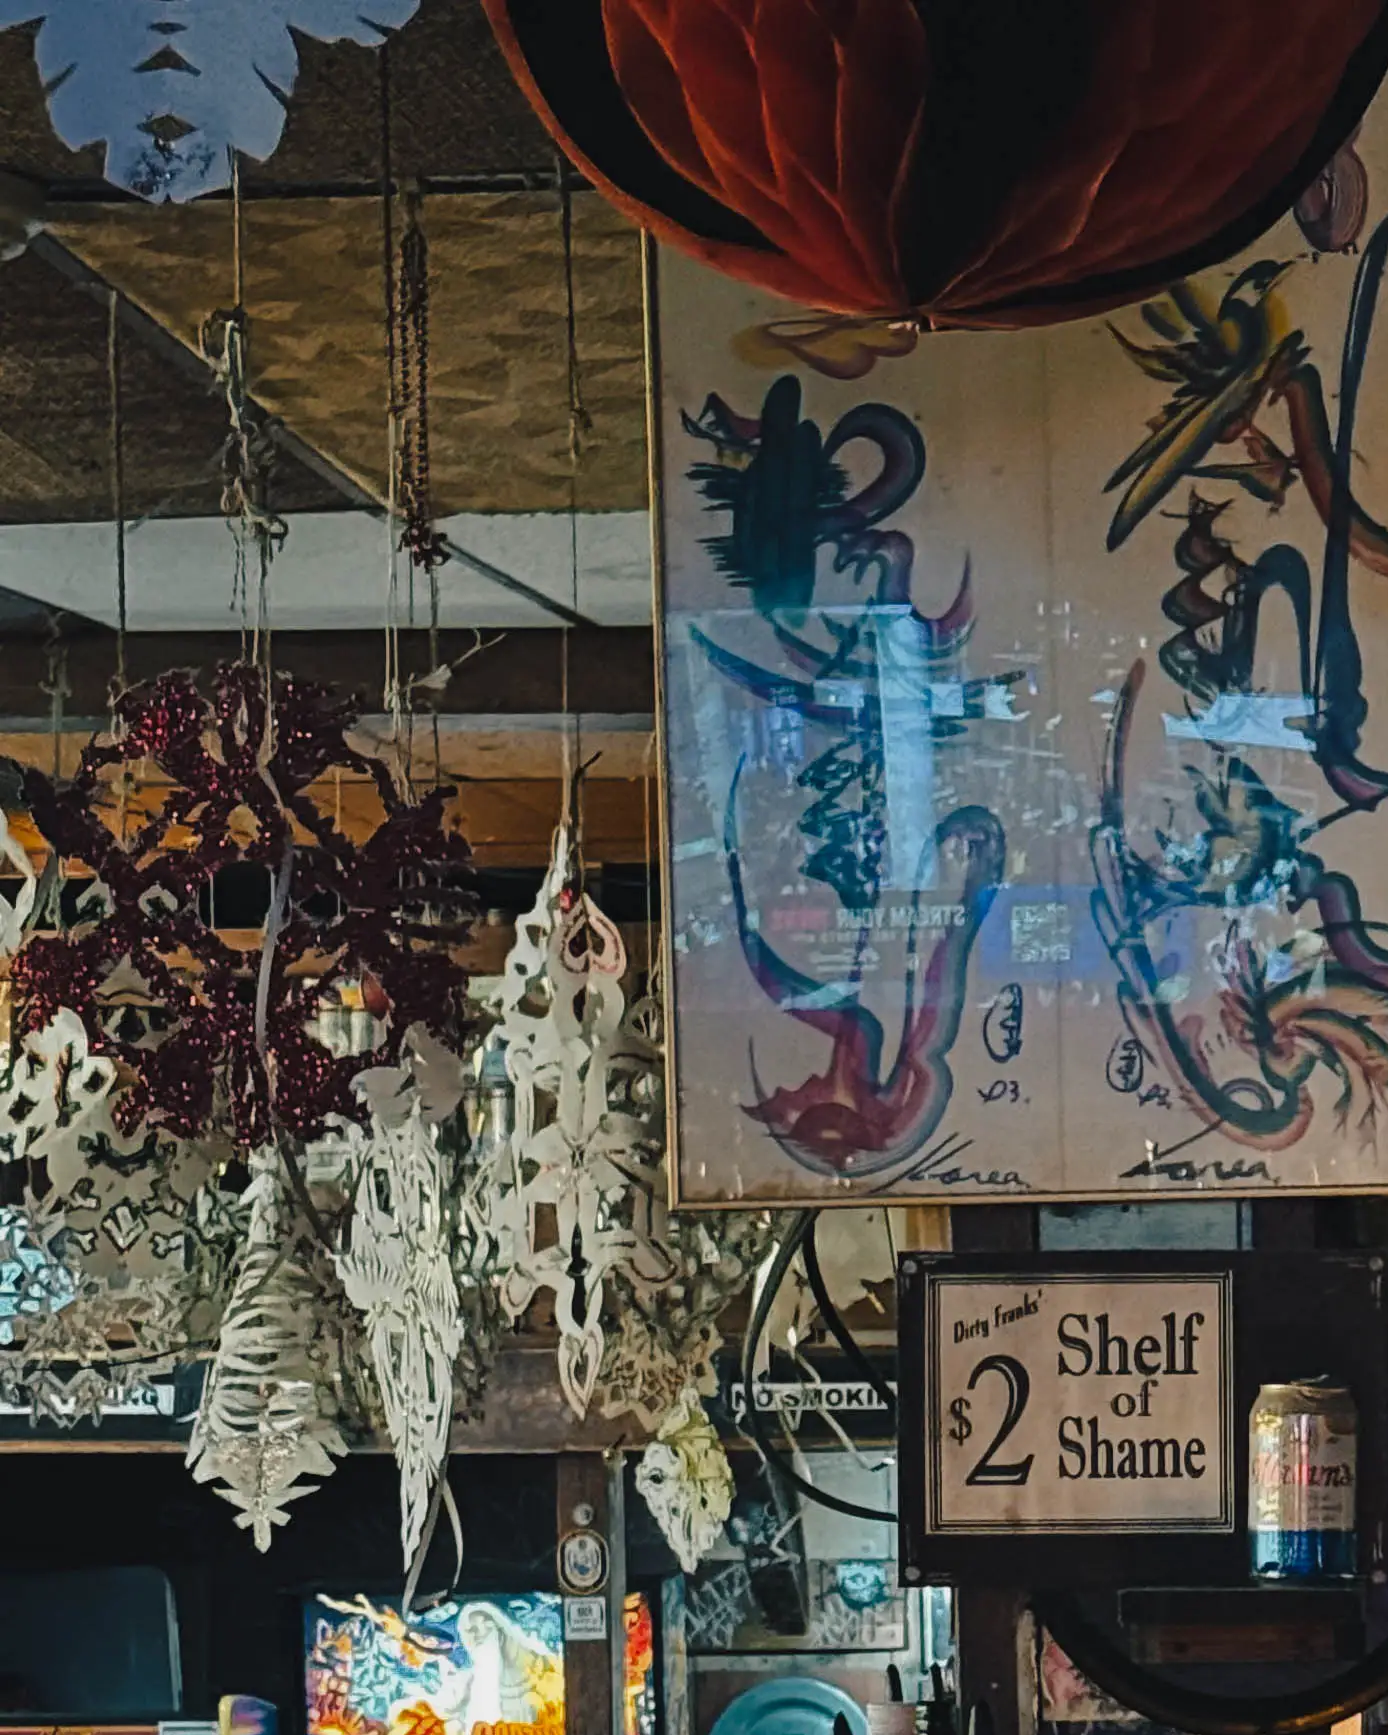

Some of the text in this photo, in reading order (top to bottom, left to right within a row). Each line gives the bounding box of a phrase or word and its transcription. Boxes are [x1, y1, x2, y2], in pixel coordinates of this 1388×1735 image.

[954, 1319, 989, 1344] Dirty
[1057, 1312, 1204, 1377] Shelf
[783, 1388, 890, 1407] SMOKI
[949, 1354, 1034, 1486] $2
[1110, 1380, 1158, 1418] of
[1058, 1417, 1206, 1480] Shame
